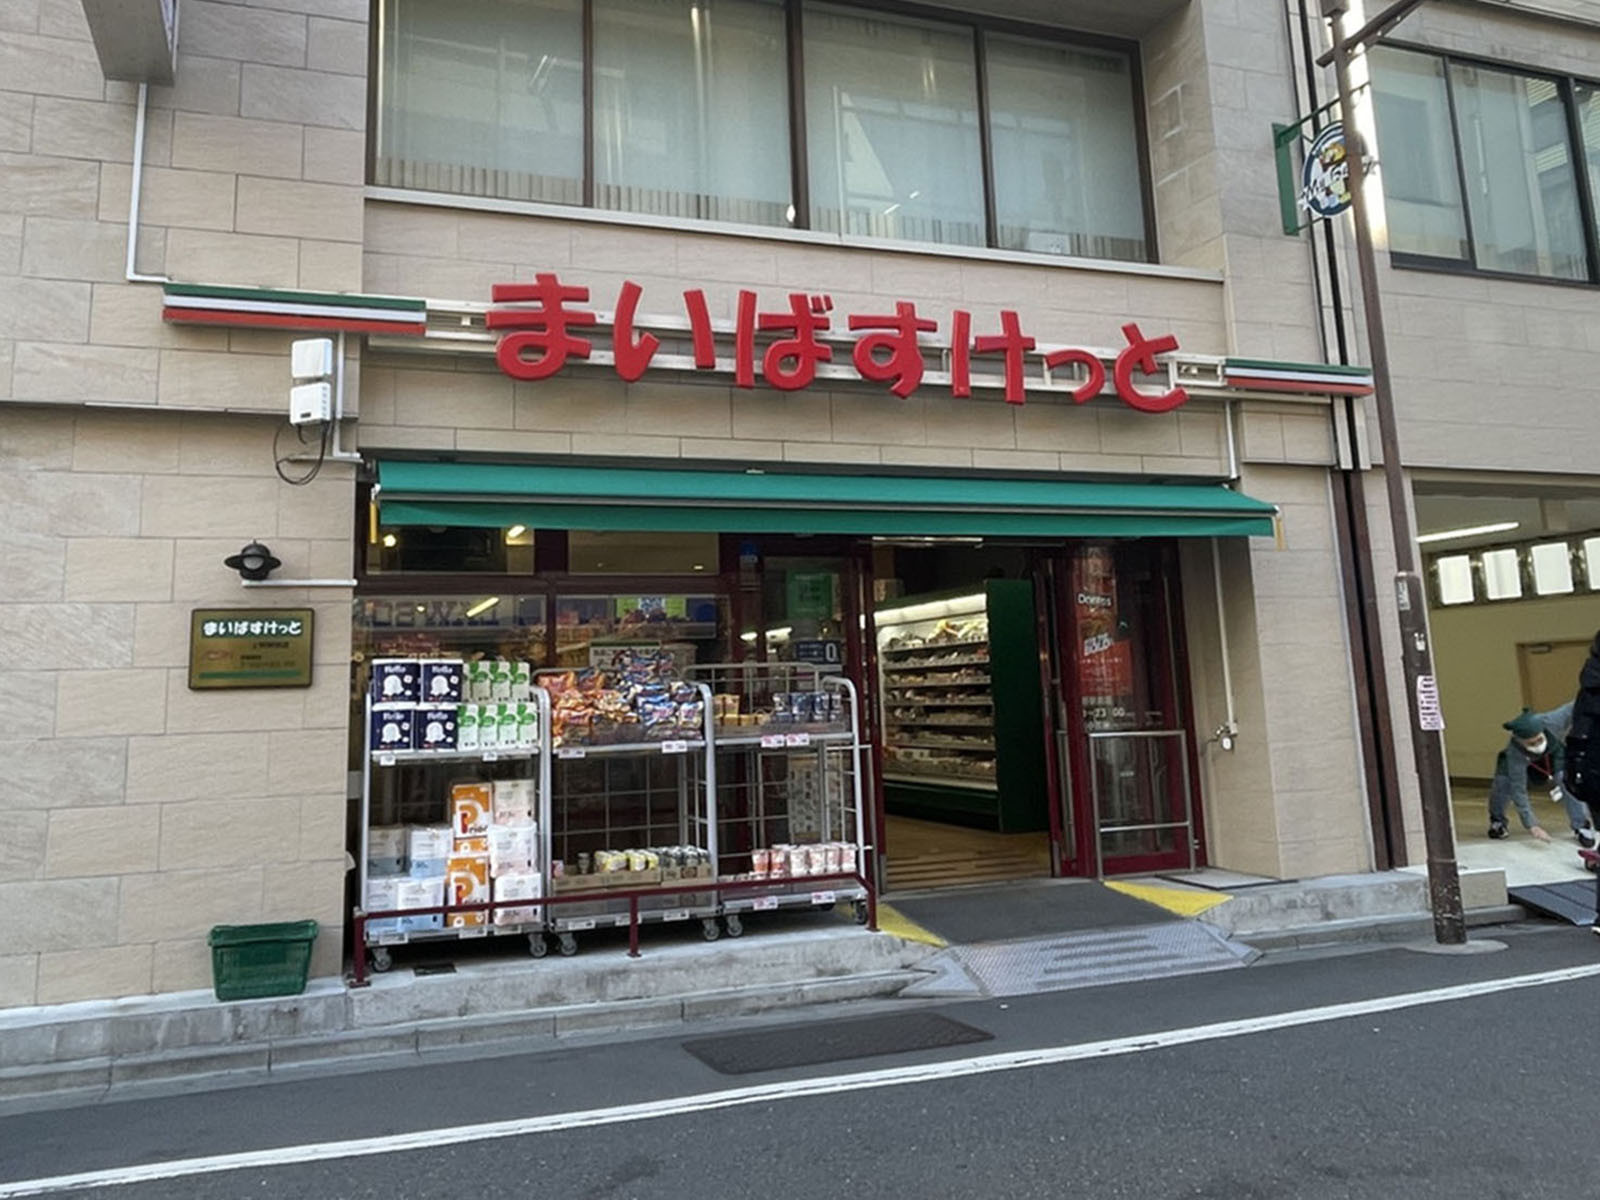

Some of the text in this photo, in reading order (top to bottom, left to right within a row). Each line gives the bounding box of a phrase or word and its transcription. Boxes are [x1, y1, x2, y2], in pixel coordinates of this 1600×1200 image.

[485, 272, 1188, 413] まいばすけっと
[203, 620, 302, 636] まいばすけっと
